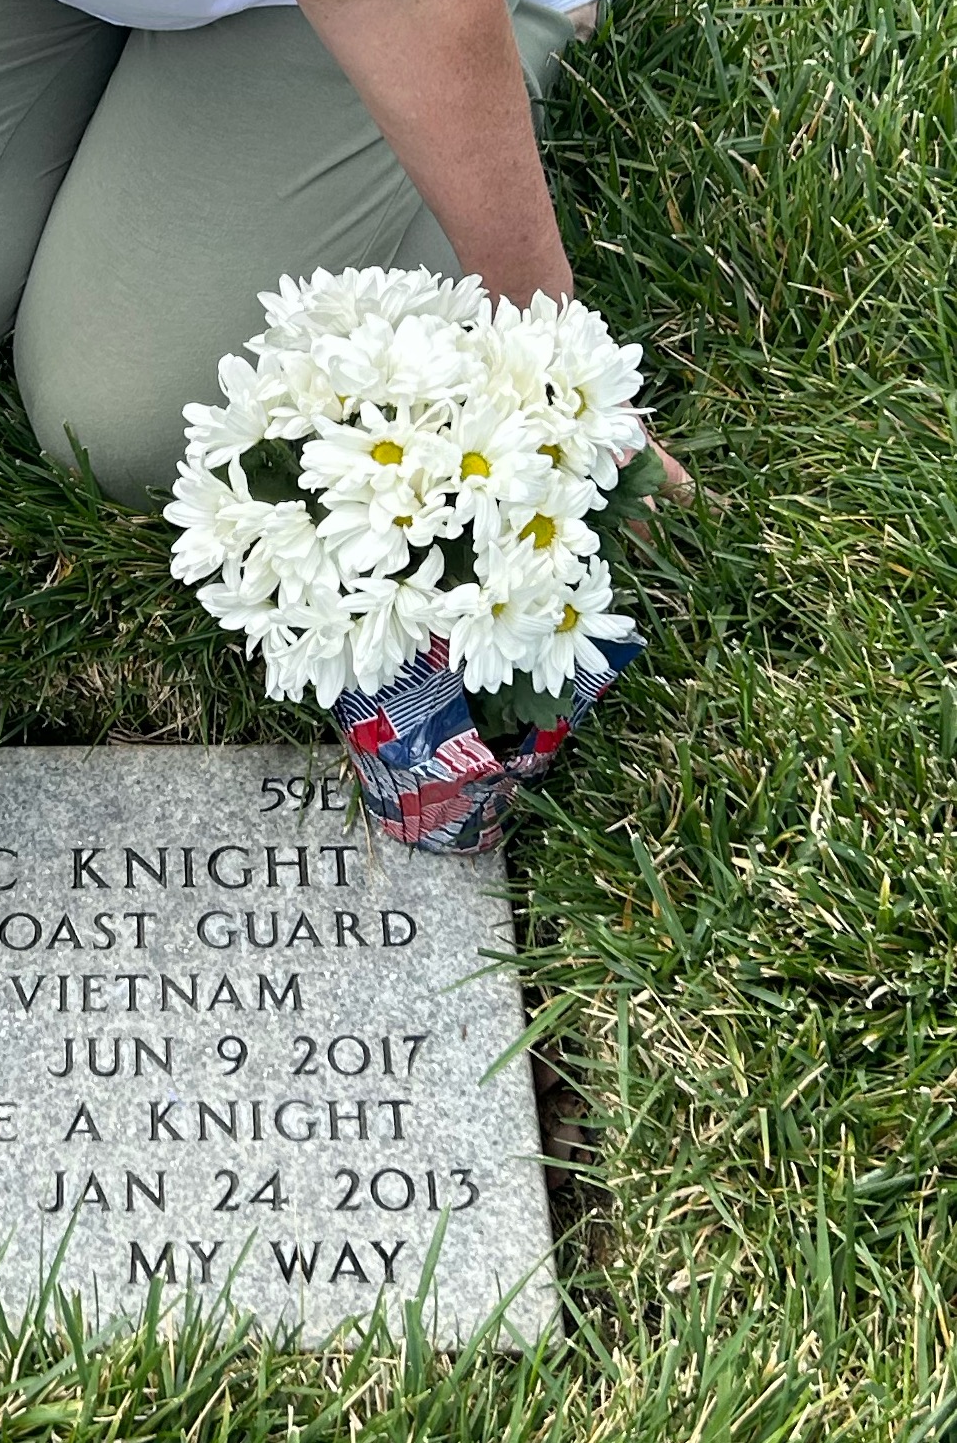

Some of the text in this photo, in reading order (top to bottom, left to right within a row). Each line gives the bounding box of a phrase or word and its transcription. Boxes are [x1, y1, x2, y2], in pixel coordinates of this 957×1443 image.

[70, 845, 359, 890] KNIGHT
[196, 910, 418, 949] GUARD
[10, 972, 306, 1014] VIETNAM
[47, 1037, 175, 1078] JUN
[216, 1035, 249, 1076] 9
[292, 1035, 429, 1076] 2017
[63, 1102, 103, 1142] A
[148, 1099, 412, 1142] KNIGHT
[38, 1170, 168, 1213] JAN
[213, 1169, 290, 1212] 24
[334, 1168, 480, 1212] 2013
[127, 1240, 225, 1284] MY
[268, 1240, 409, 1285] WAY
